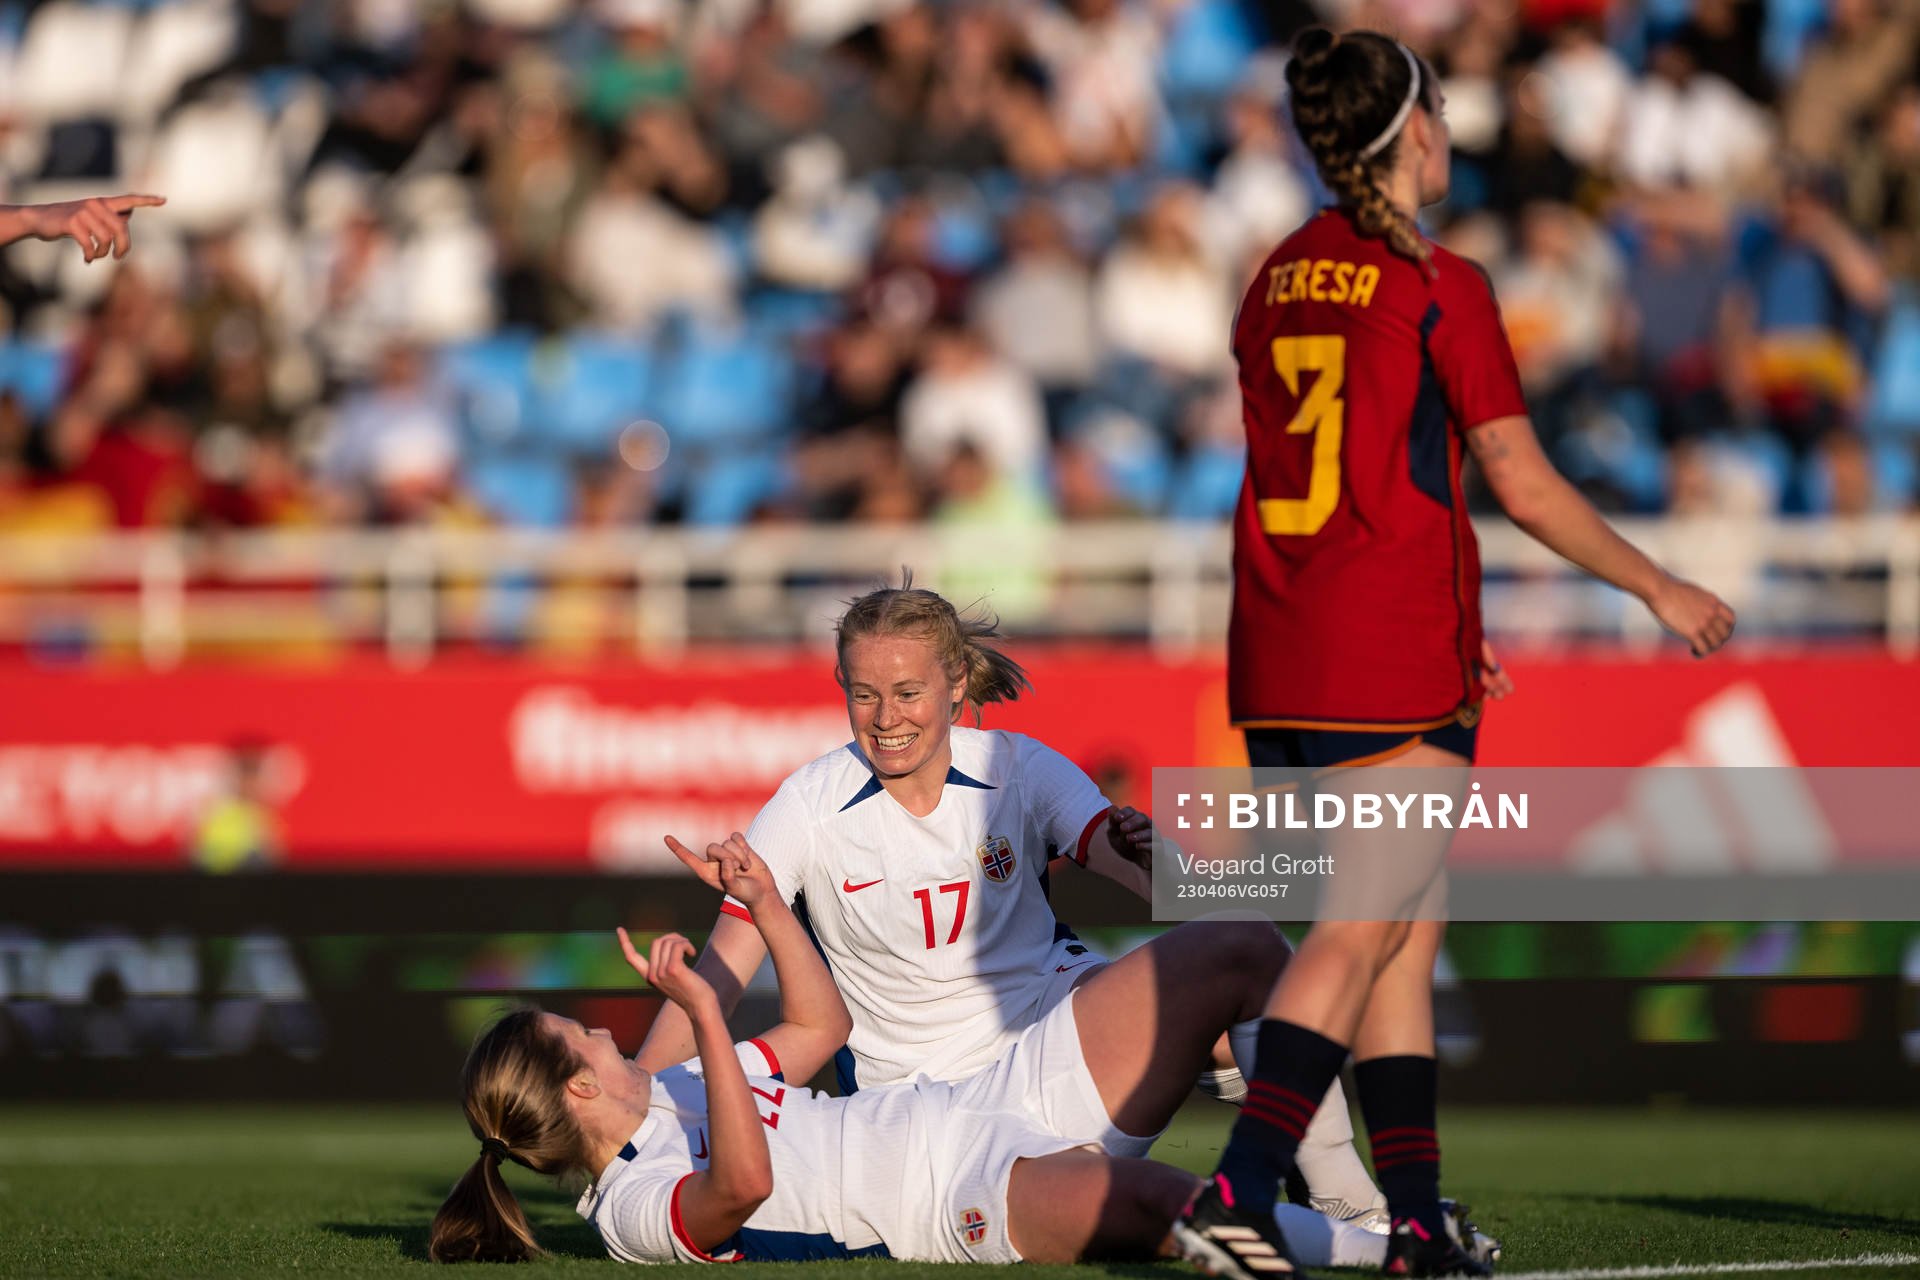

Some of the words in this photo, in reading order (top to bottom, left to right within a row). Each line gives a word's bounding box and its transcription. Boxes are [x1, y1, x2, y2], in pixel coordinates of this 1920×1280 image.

[1266, 258, 1380, 308] TERESA
[1258, 335, 1346, 536] 3
[913, 880, 970, 950] 17
